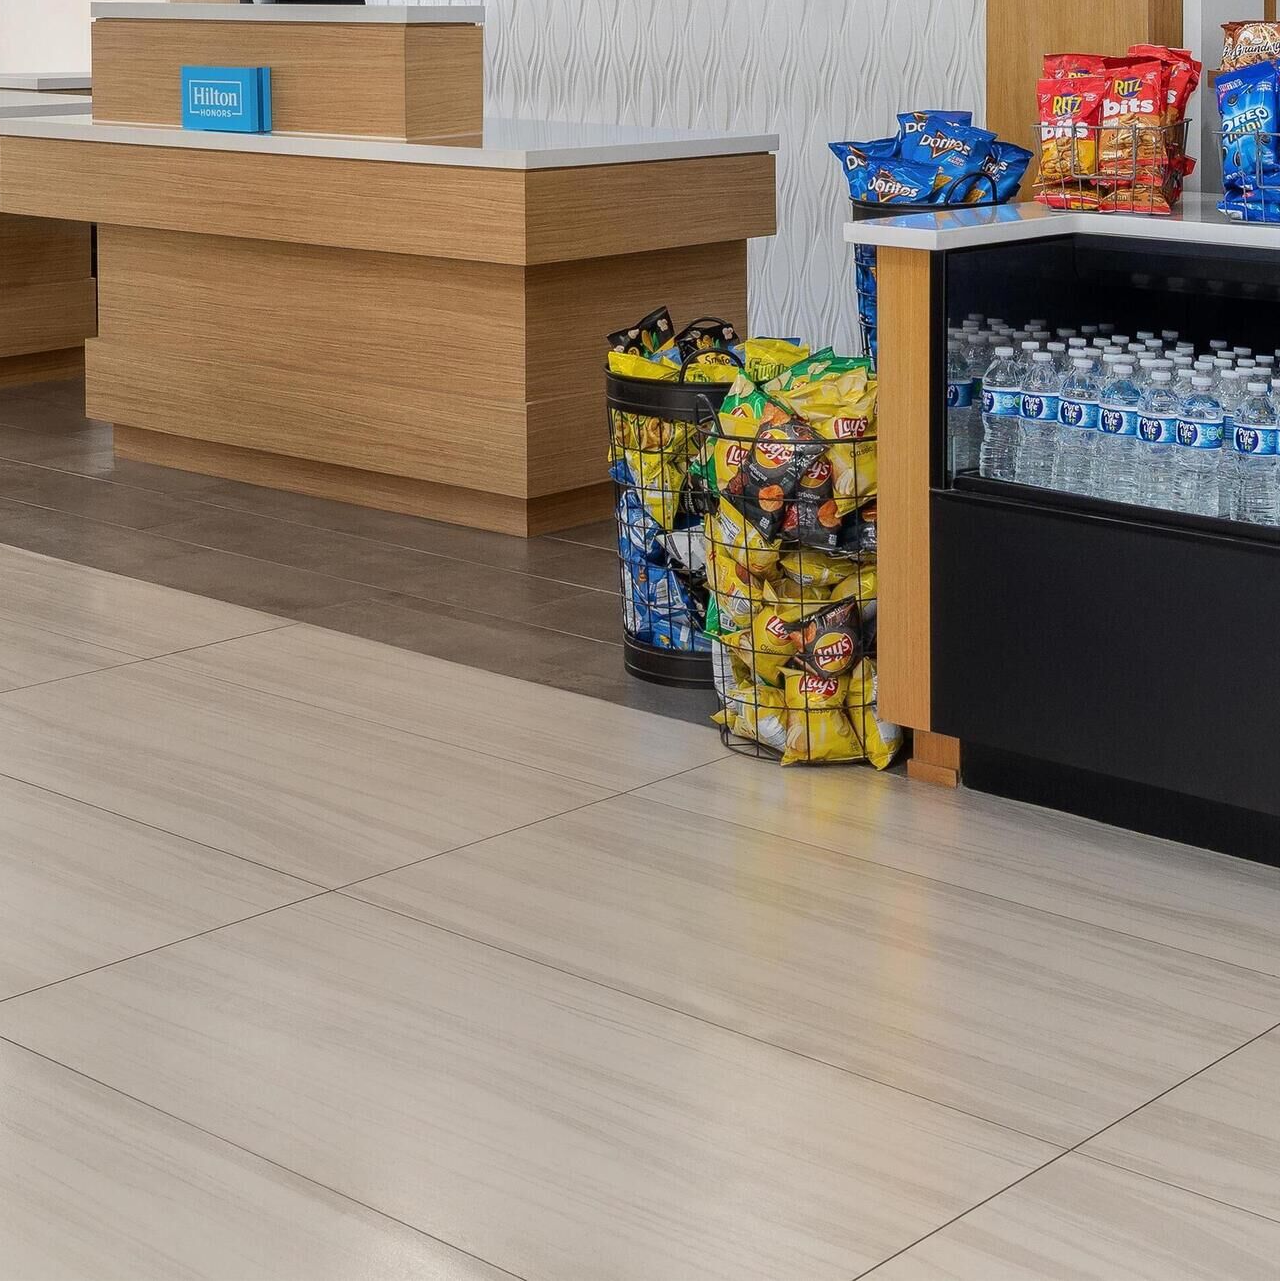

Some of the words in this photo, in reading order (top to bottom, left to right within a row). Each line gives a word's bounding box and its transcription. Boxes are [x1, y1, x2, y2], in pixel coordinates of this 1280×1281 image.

[1114, 79, 1143, 96] RITZ
[194, 87, 238, 107] Hilton
[1053, 94, 1083, 116] RITZ
[200, 109, 232, 118] HONORS
[1104, 99, 1153, 117] bits
[1223, 107, 1268, 133] OREO
[1042, 119, 1089, 141] bits
[920, 134, 970, 156] Doritos
[868, 176, 919, 198] Doritos
[1024, 395, 1040, 404] Pure
[1026, 403, 1038, 411] Life
[1063, 401, 1079, 411] Pure
[1065, 410, 1077, 418] Life
[837, 417, 869, 438] Lay's
[1179, 421, 1195, 432] Pure
[1180, 429, 1193, 438] Life
[817, 637, 851, 666] Lay's
[801, 675, 837, 694] Lay's
